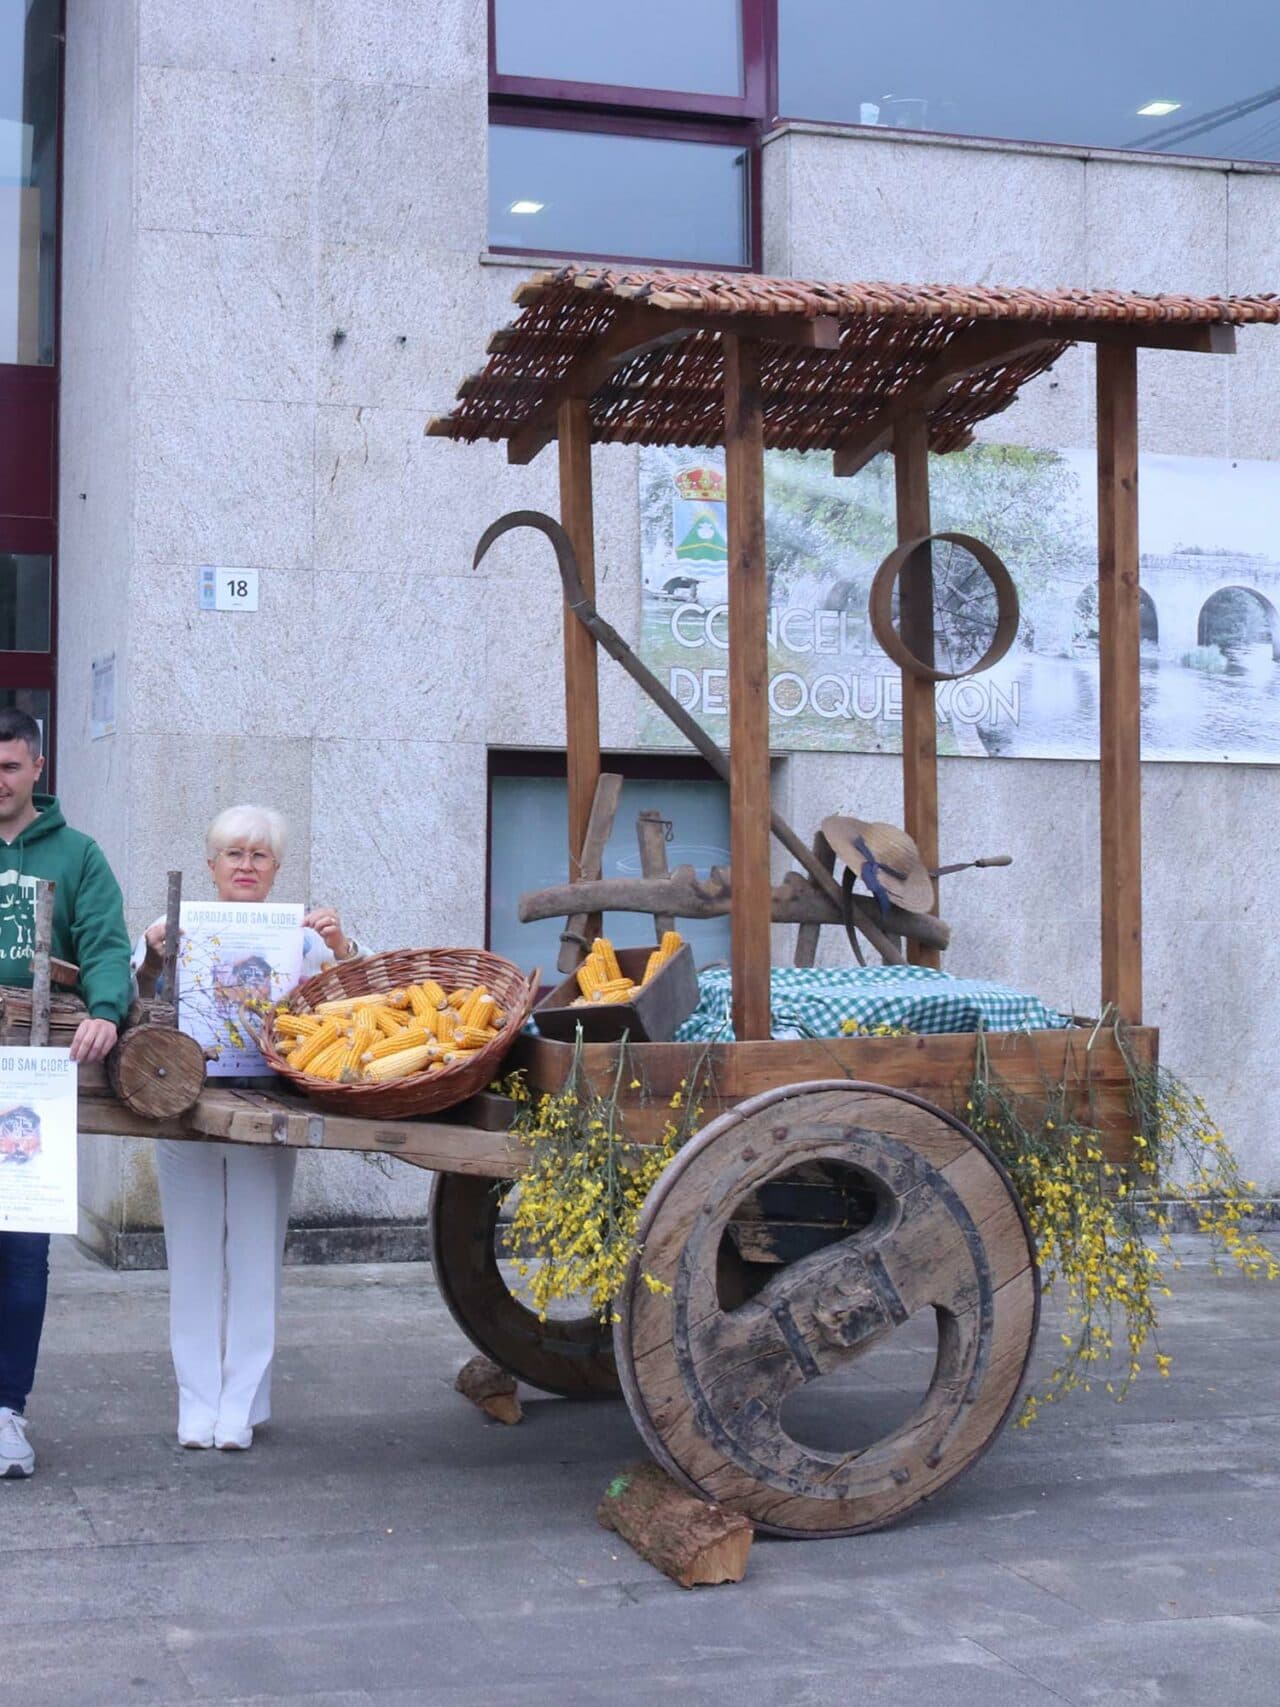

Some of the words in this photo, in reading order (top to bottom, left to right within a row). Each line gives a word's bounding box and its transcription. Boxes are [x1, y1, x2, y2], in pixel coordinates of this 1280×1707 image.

[227, 580, 248, 597] 18
[671, 667, 729, 714] DE
[250, 912, 268, 924] SAN
[9, 944, 35, 960] Cidr
[1, 1058, 14, 1071] DO
[17, 1058, 37, 1072] SAN
[40, 1059, 69, 1072] CIDRE
